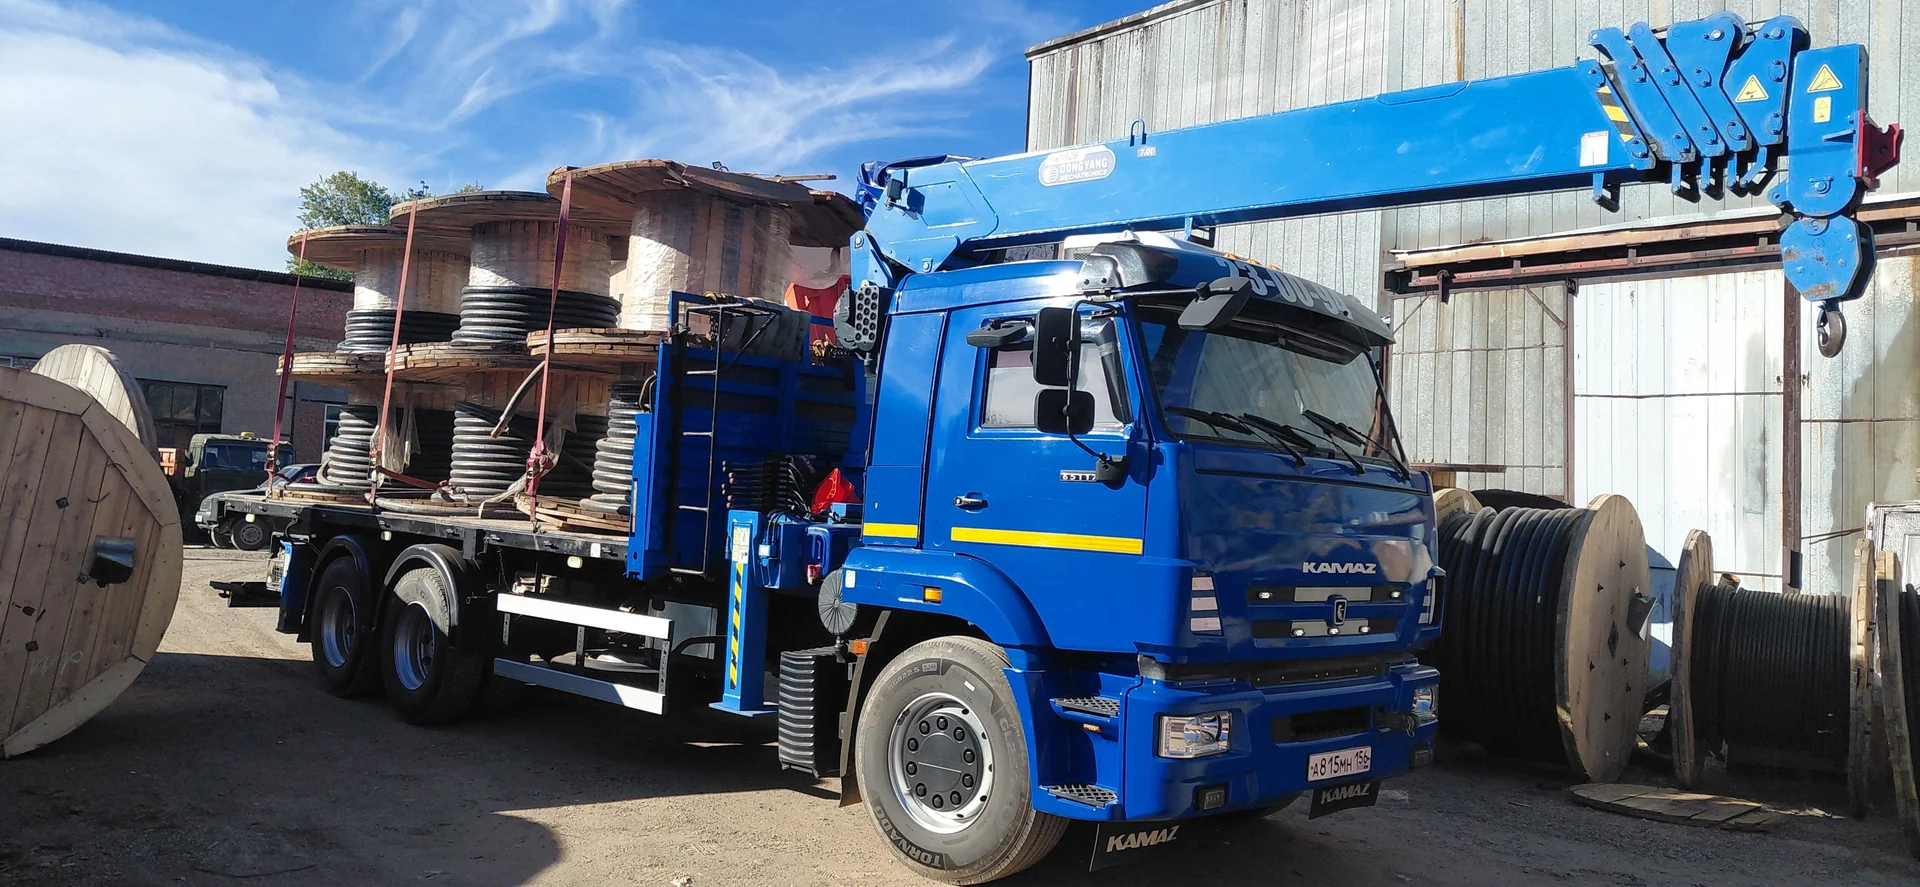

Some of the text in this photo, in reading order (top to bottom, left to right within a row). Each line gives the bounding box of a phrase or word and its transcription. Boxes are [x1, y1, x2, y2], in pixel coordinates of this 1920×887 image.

[1060, 157, 1108, 174] DONGYANG
[1060, 169, 1108, 181] MECHATRONICS
[1302, 562, 1377, 574] KAMAZ
[1355, 750, 1368, 767] 156
[1320, 783, 1371, 804] KAMAZ
[874, 805, 941, 867] TORNADO
[1106, 825, 1180, 852] KAMAZ
